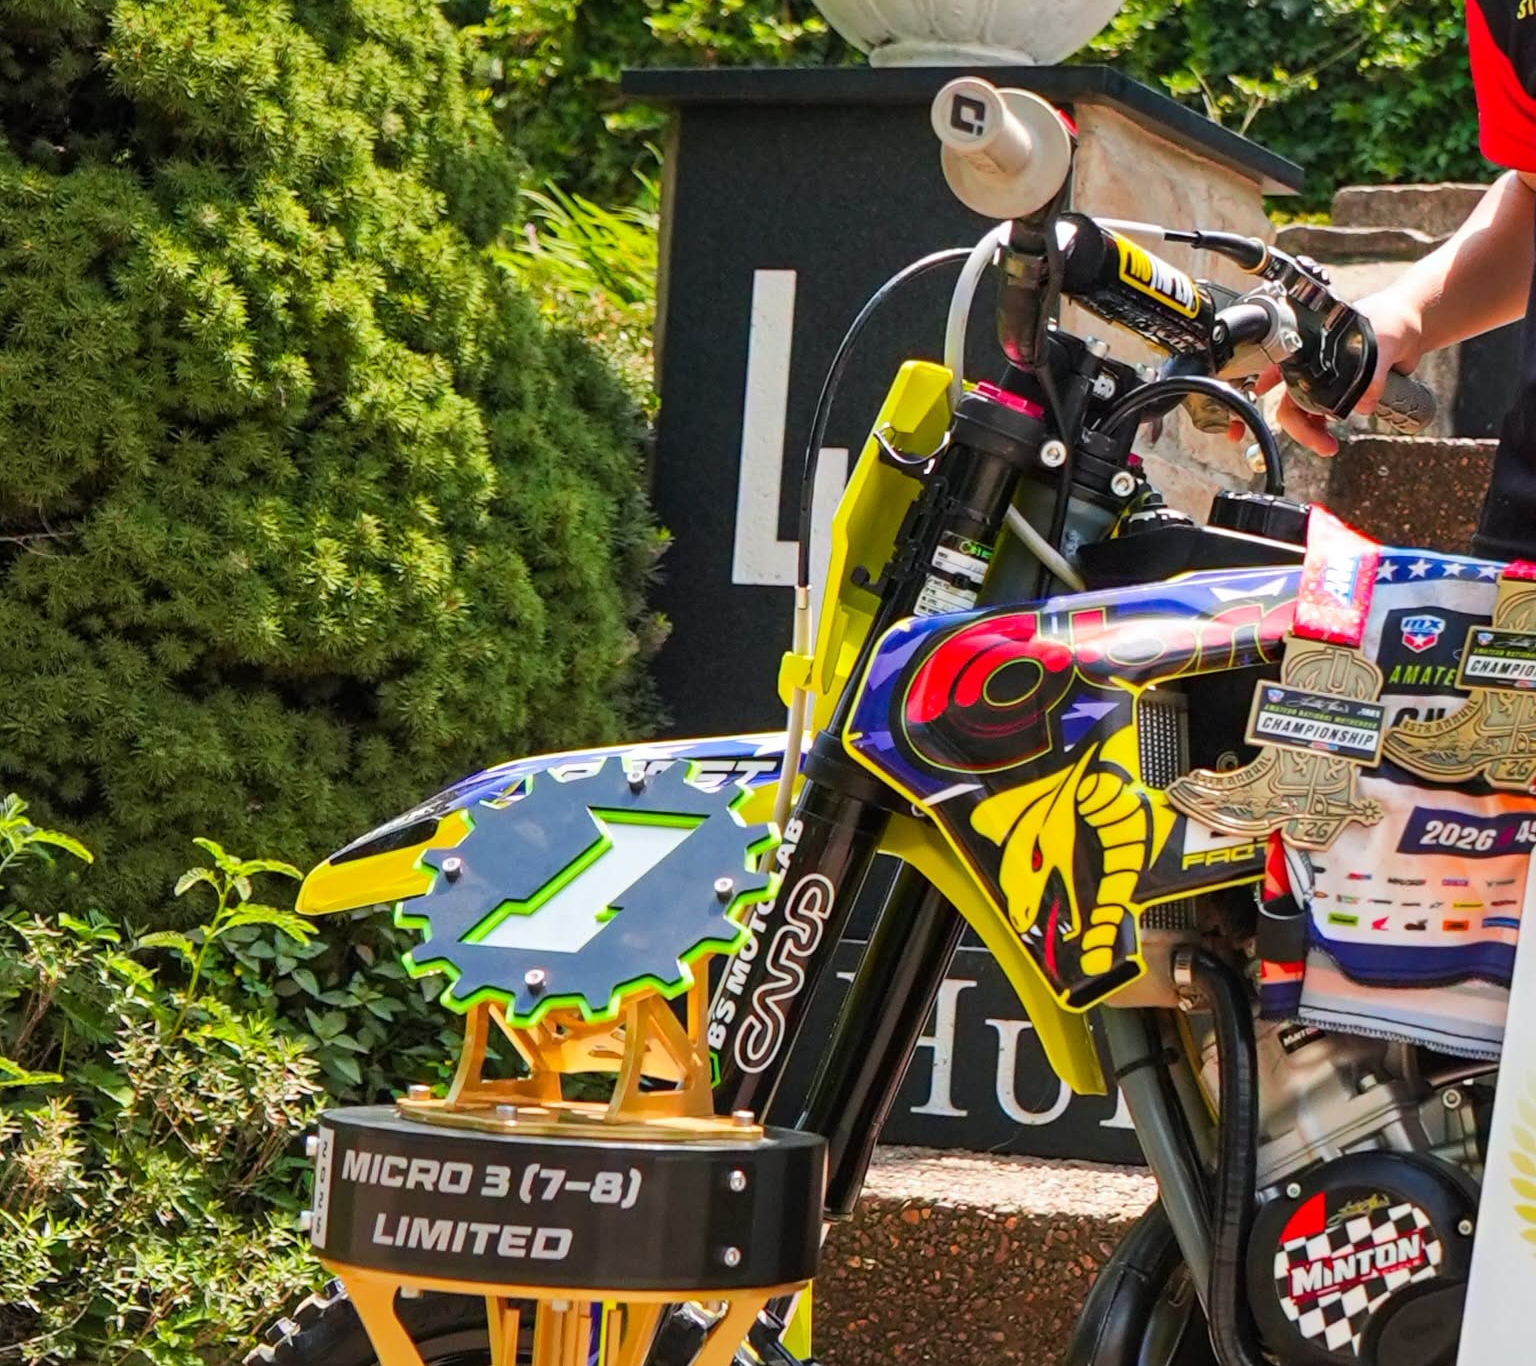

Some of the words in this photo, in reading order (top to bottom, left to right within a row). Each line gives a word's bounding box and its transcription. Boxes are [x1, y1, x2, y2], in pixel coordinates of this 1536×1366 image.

[1261, 716, 1375, 747] CHAMPIONSHIP
[1420, 819, 1498, 851] 2026
[341, 1148, 474, 1195] MICRO
[480, 1165, 512, 1199] 3
[519, 1162, 643, 1210] (7-8)
[372, 1212, 574, 1261] LIMITED
